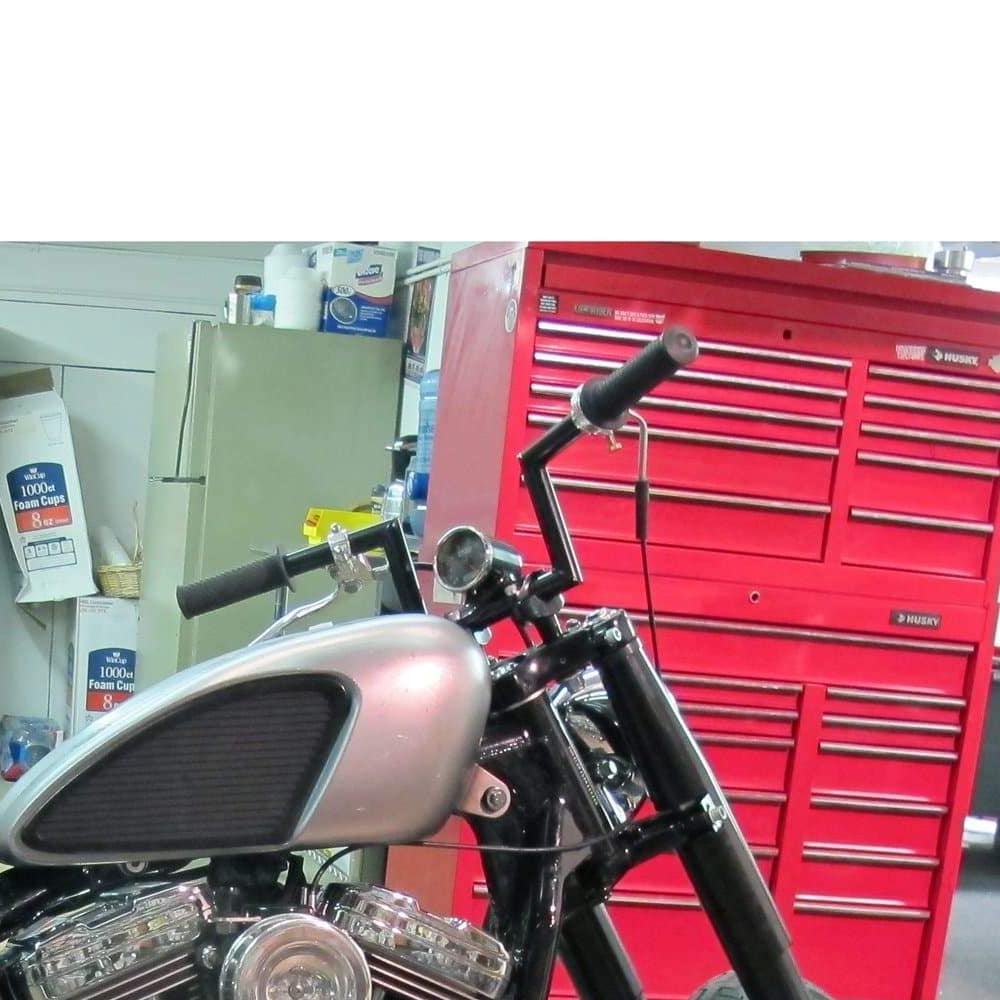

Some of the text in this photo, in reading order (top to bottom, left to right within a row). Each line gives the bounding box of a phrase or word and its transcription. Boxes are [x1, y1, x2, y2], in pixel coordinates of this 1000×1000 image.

[944, 353, 978, 366] HUSKY
[14, 494, 66, 511] Foam Cups
[32, 511, 42, 528] 8
[906, 615, 939, 627] HUSKY
[88, 679, 136, 693] Foam Cup
[103, 694, 113, 710] 8
